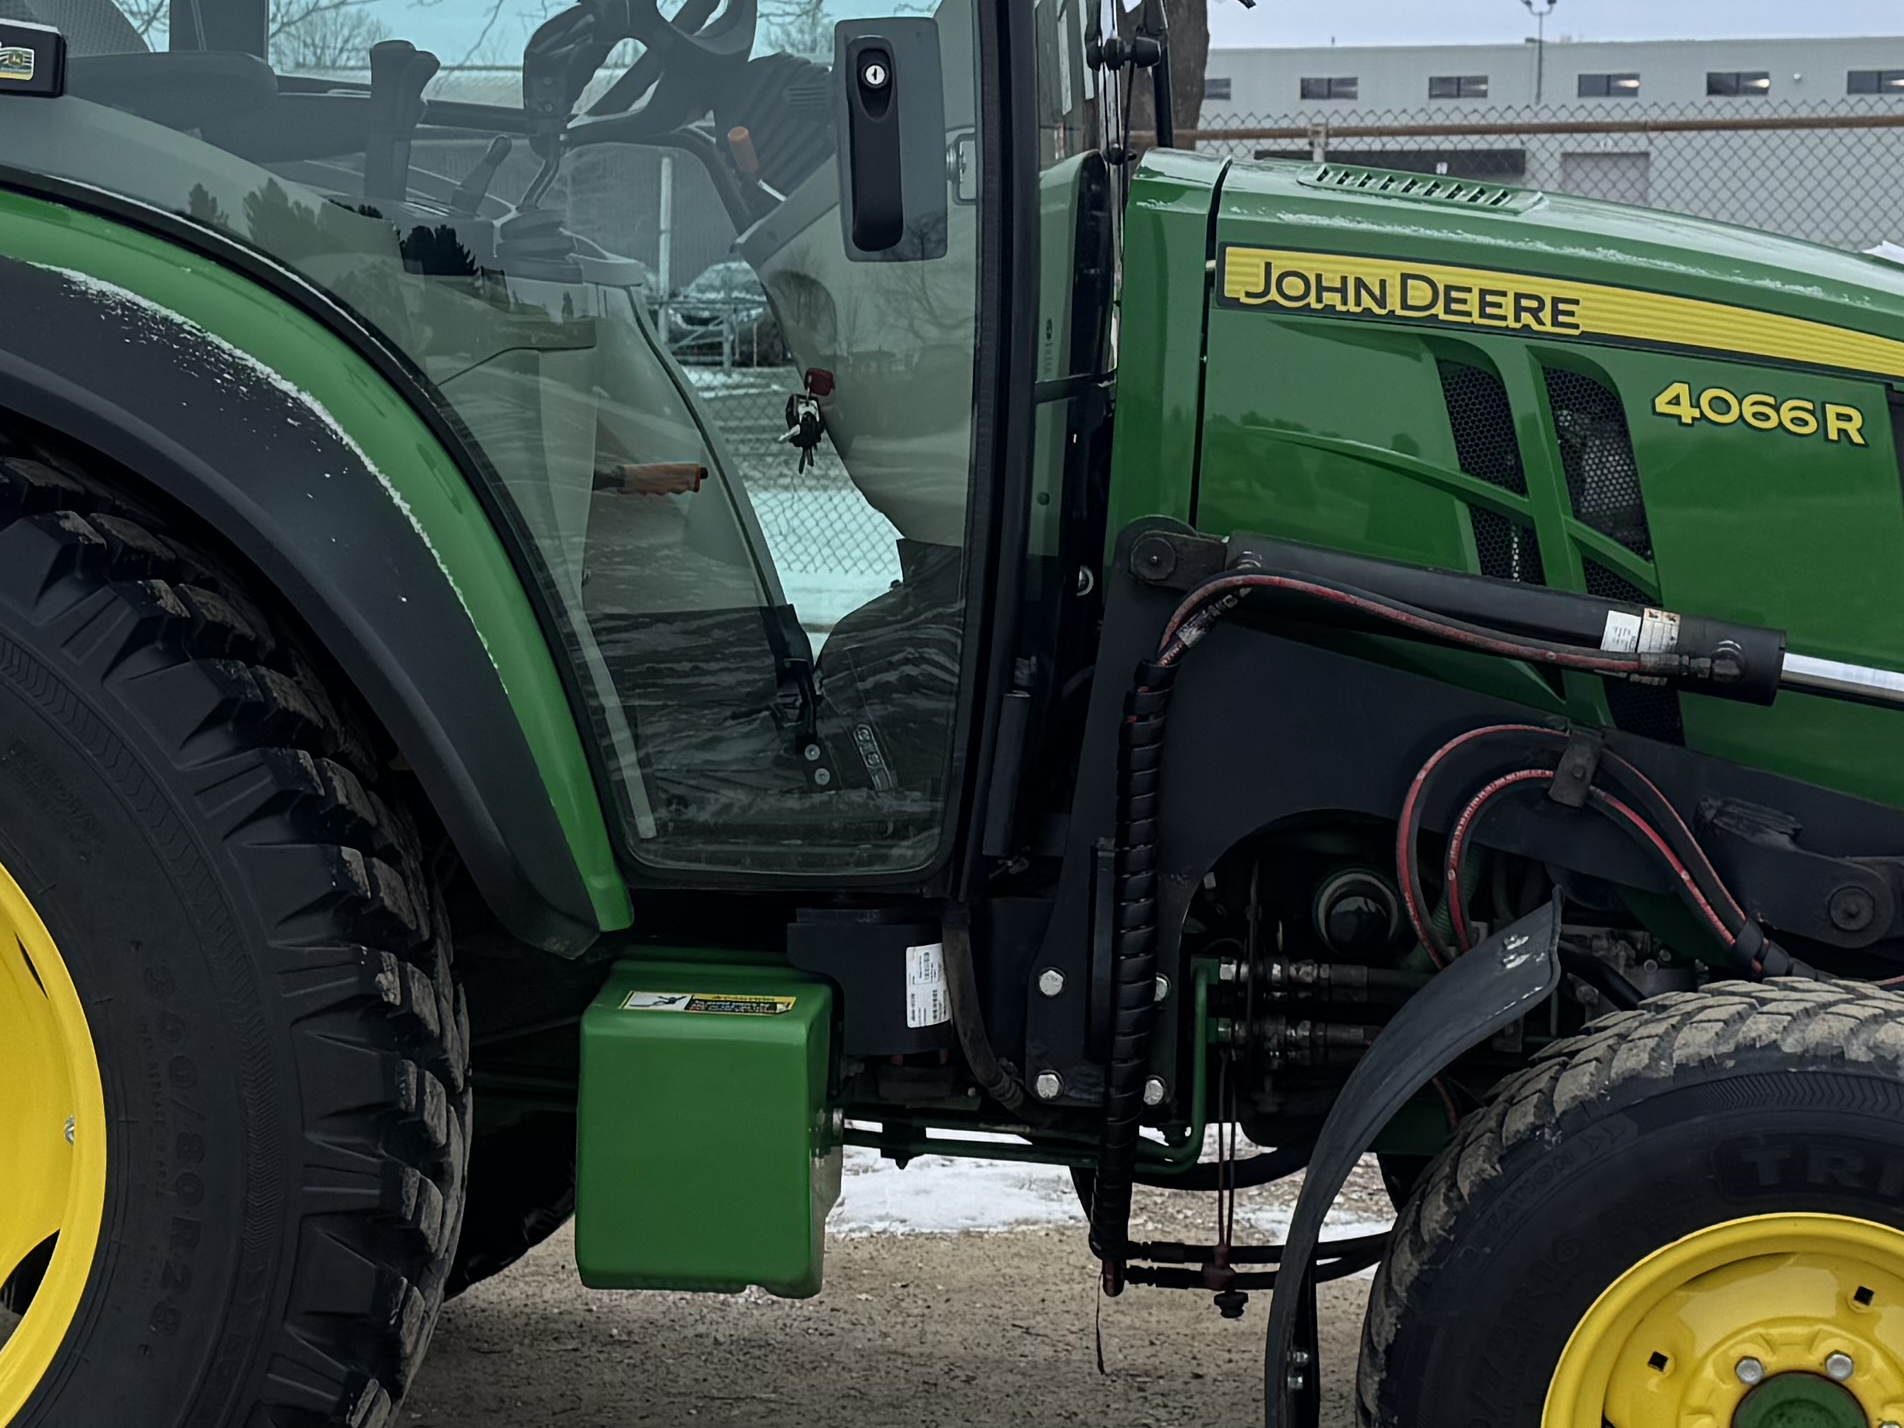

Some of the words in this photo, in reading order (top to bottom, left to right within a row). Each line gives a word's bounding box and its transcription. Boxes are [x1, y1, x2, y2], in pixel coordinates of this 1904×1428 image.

[1244, 260, 1388, 311] JOHN
[1399, 272, 1582, 331] DEERE
[1653, 380, 1867, 446] 4066R
